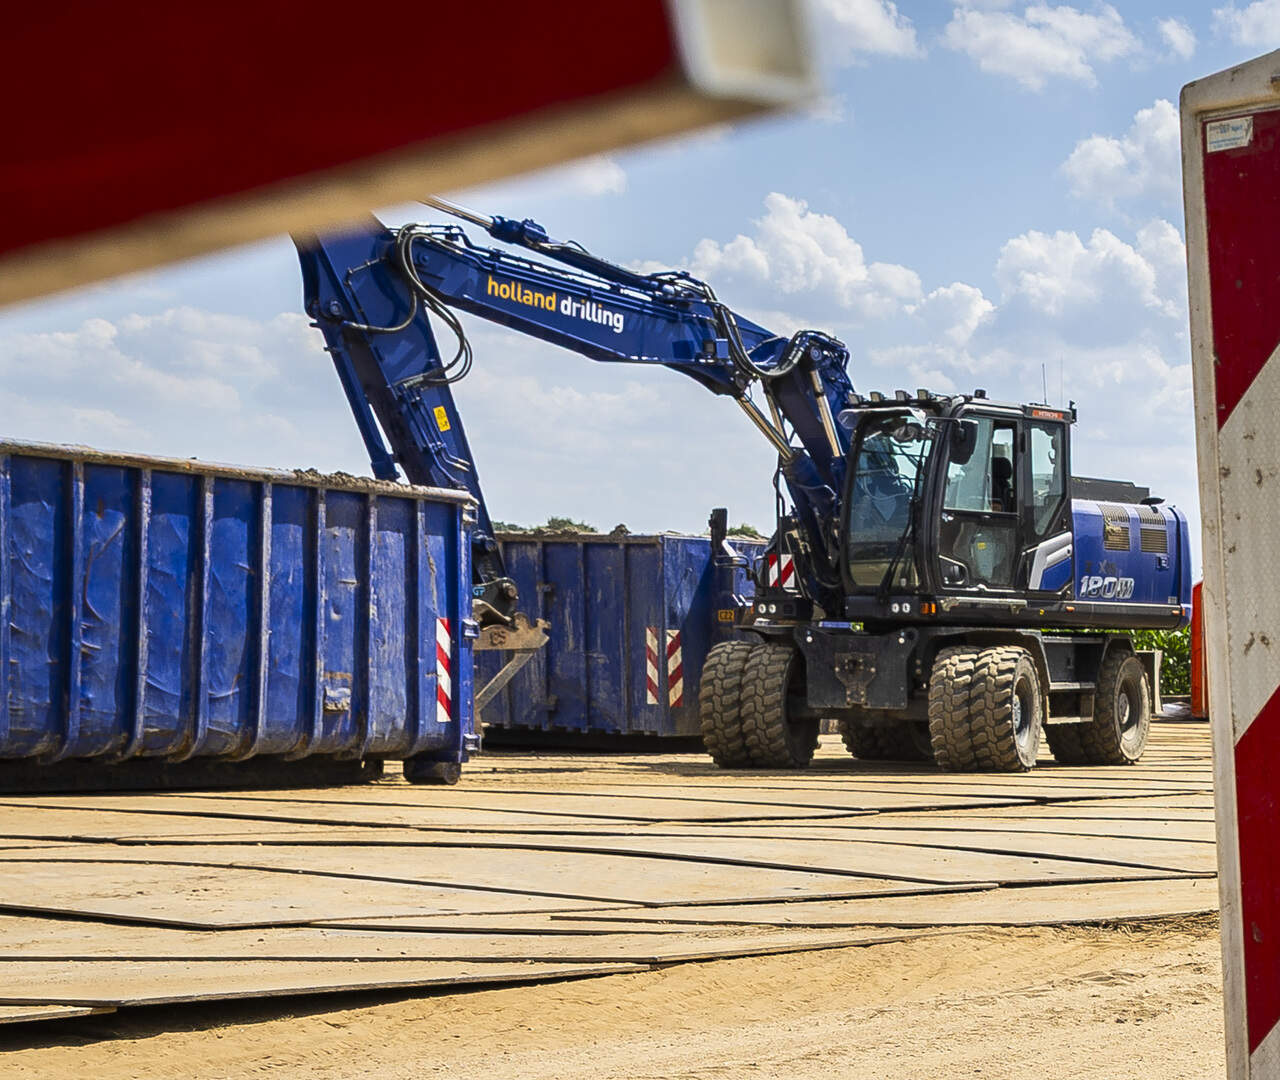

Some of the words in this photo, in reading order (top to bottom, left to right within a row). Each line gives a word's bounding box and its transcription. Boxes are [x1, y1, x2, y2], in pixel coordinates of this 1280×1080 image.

[488, 275, 557, 312] holland
[560, 295, 624, 334] drilling
[1080, 576, 1135, 599] 180W
